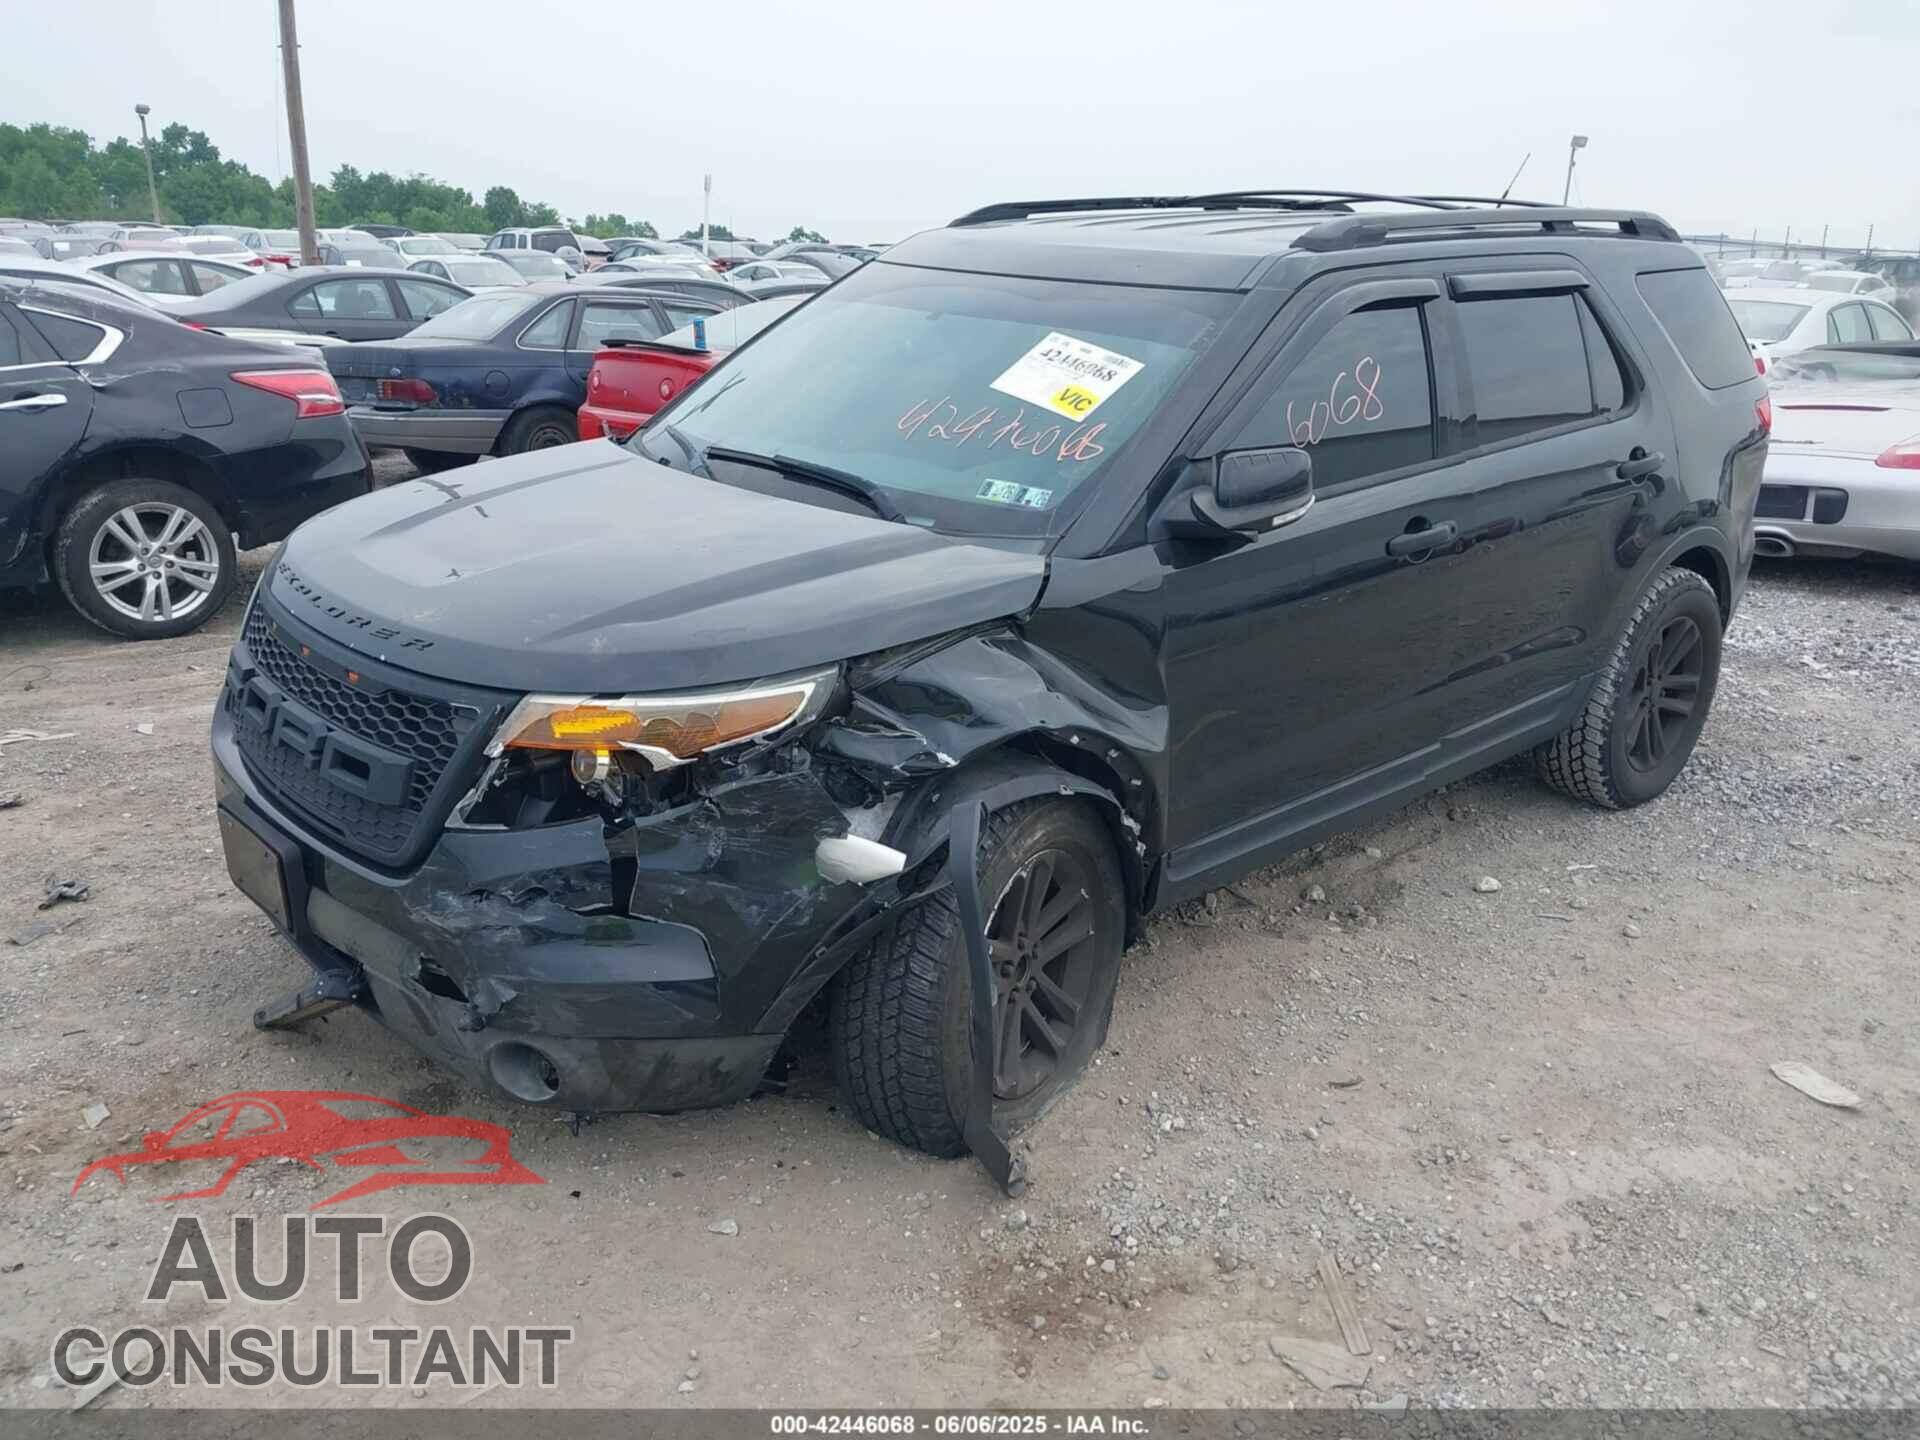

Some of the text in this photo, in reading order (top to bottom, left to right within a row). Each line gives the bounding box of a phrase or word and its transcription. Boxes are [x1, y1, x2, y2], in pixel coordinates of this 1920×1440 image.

[1059, 387, 1092, 412] VIC
[1287, 356, 1384, 448] 6068
[277, 562, 435, 652] EXPLORER
